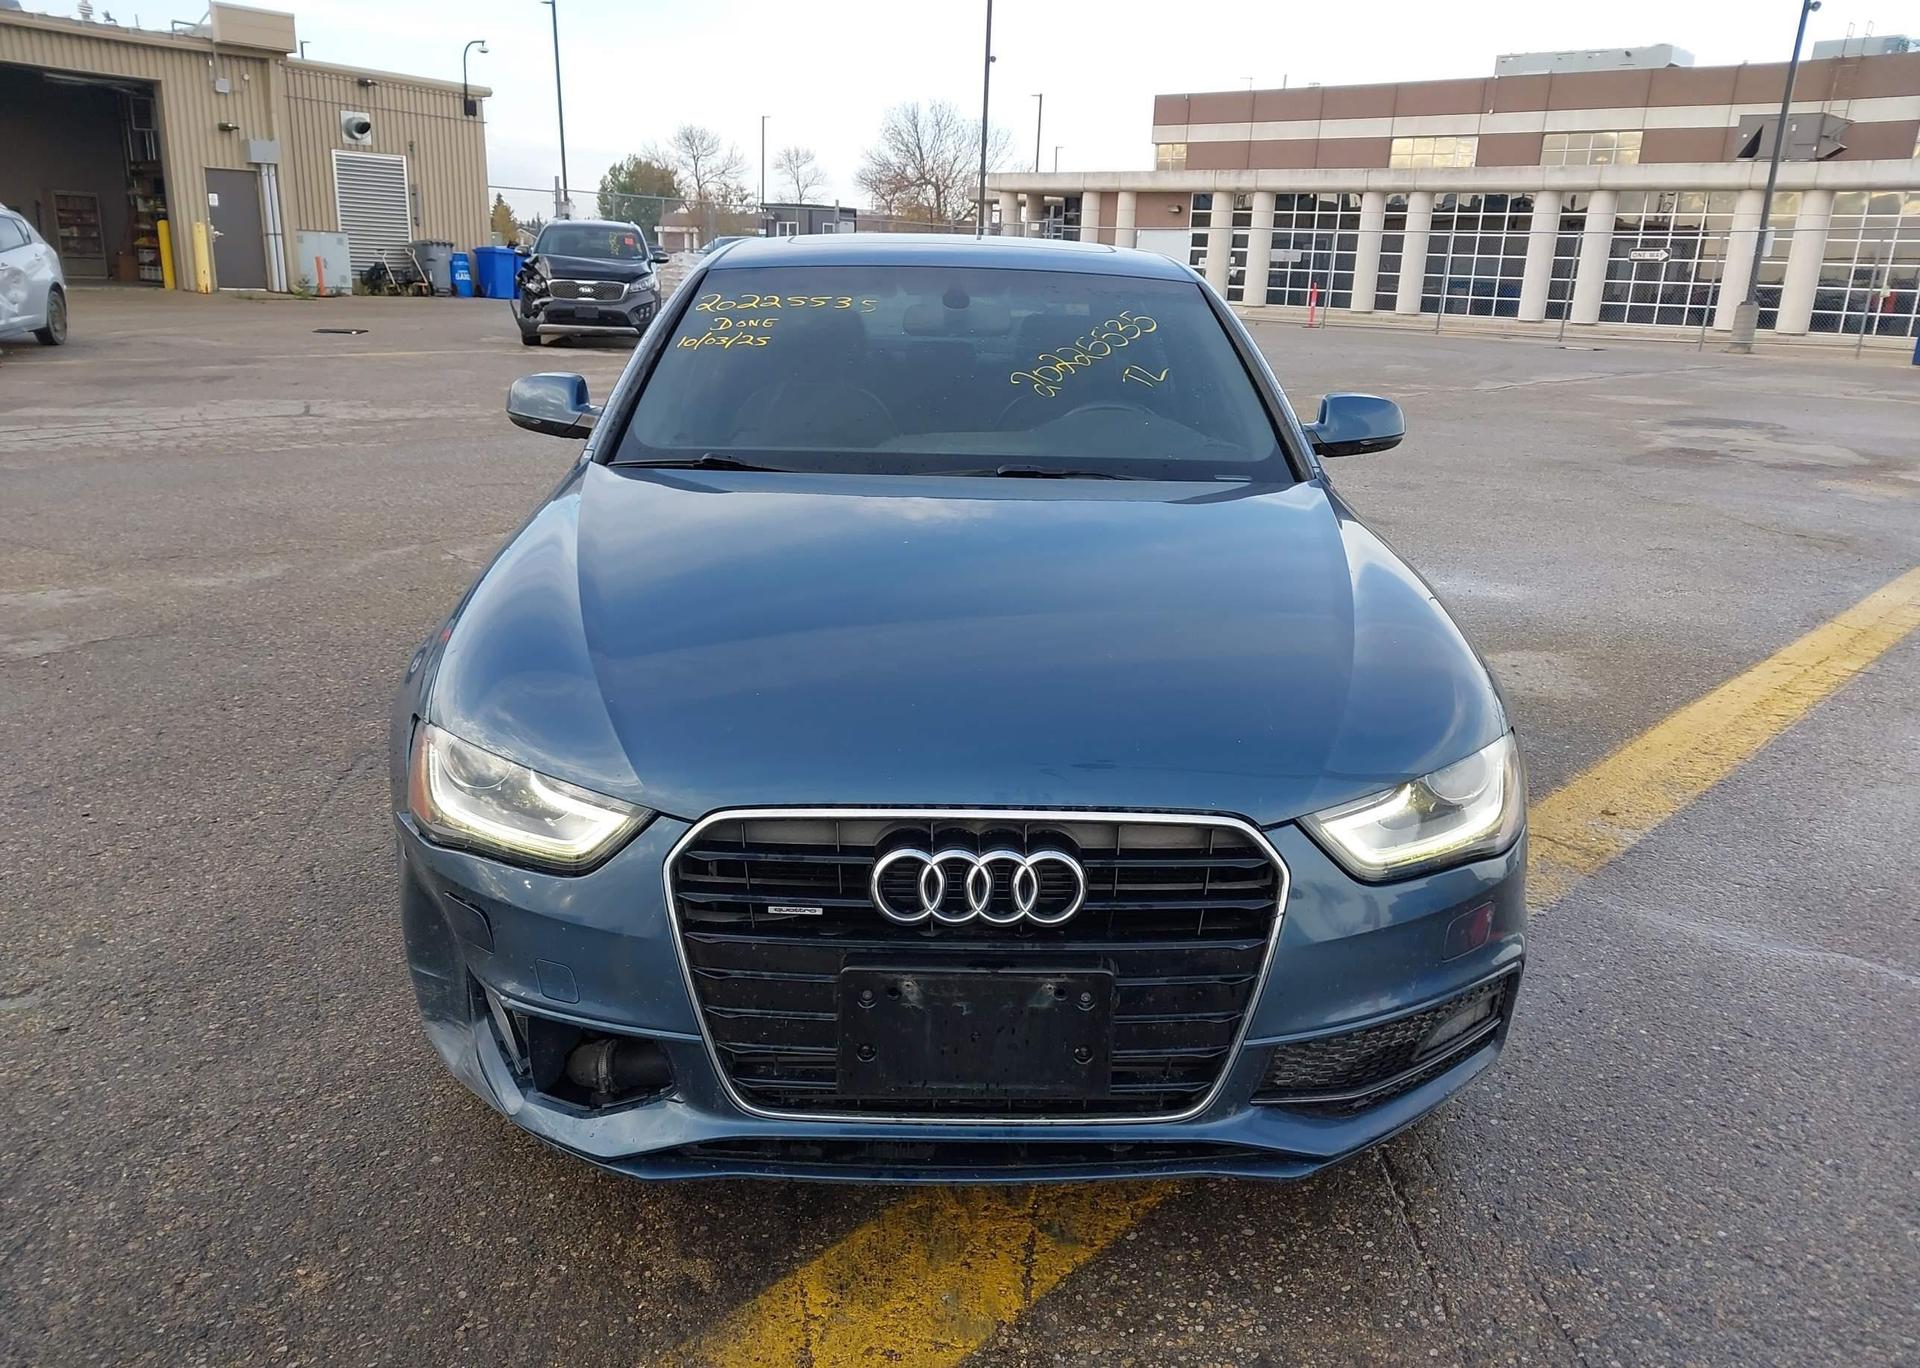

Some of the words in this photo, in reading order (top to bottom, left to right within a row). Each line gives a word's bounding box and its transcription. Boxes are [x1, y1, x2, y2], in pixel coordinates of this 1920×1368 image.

[695, 293, 880, 313] 20225535
[709, 317, 780, 331] DONE
[676, 331, 771, 350] 10/03/25
[1010, 310, 1157, 398] 20225535
